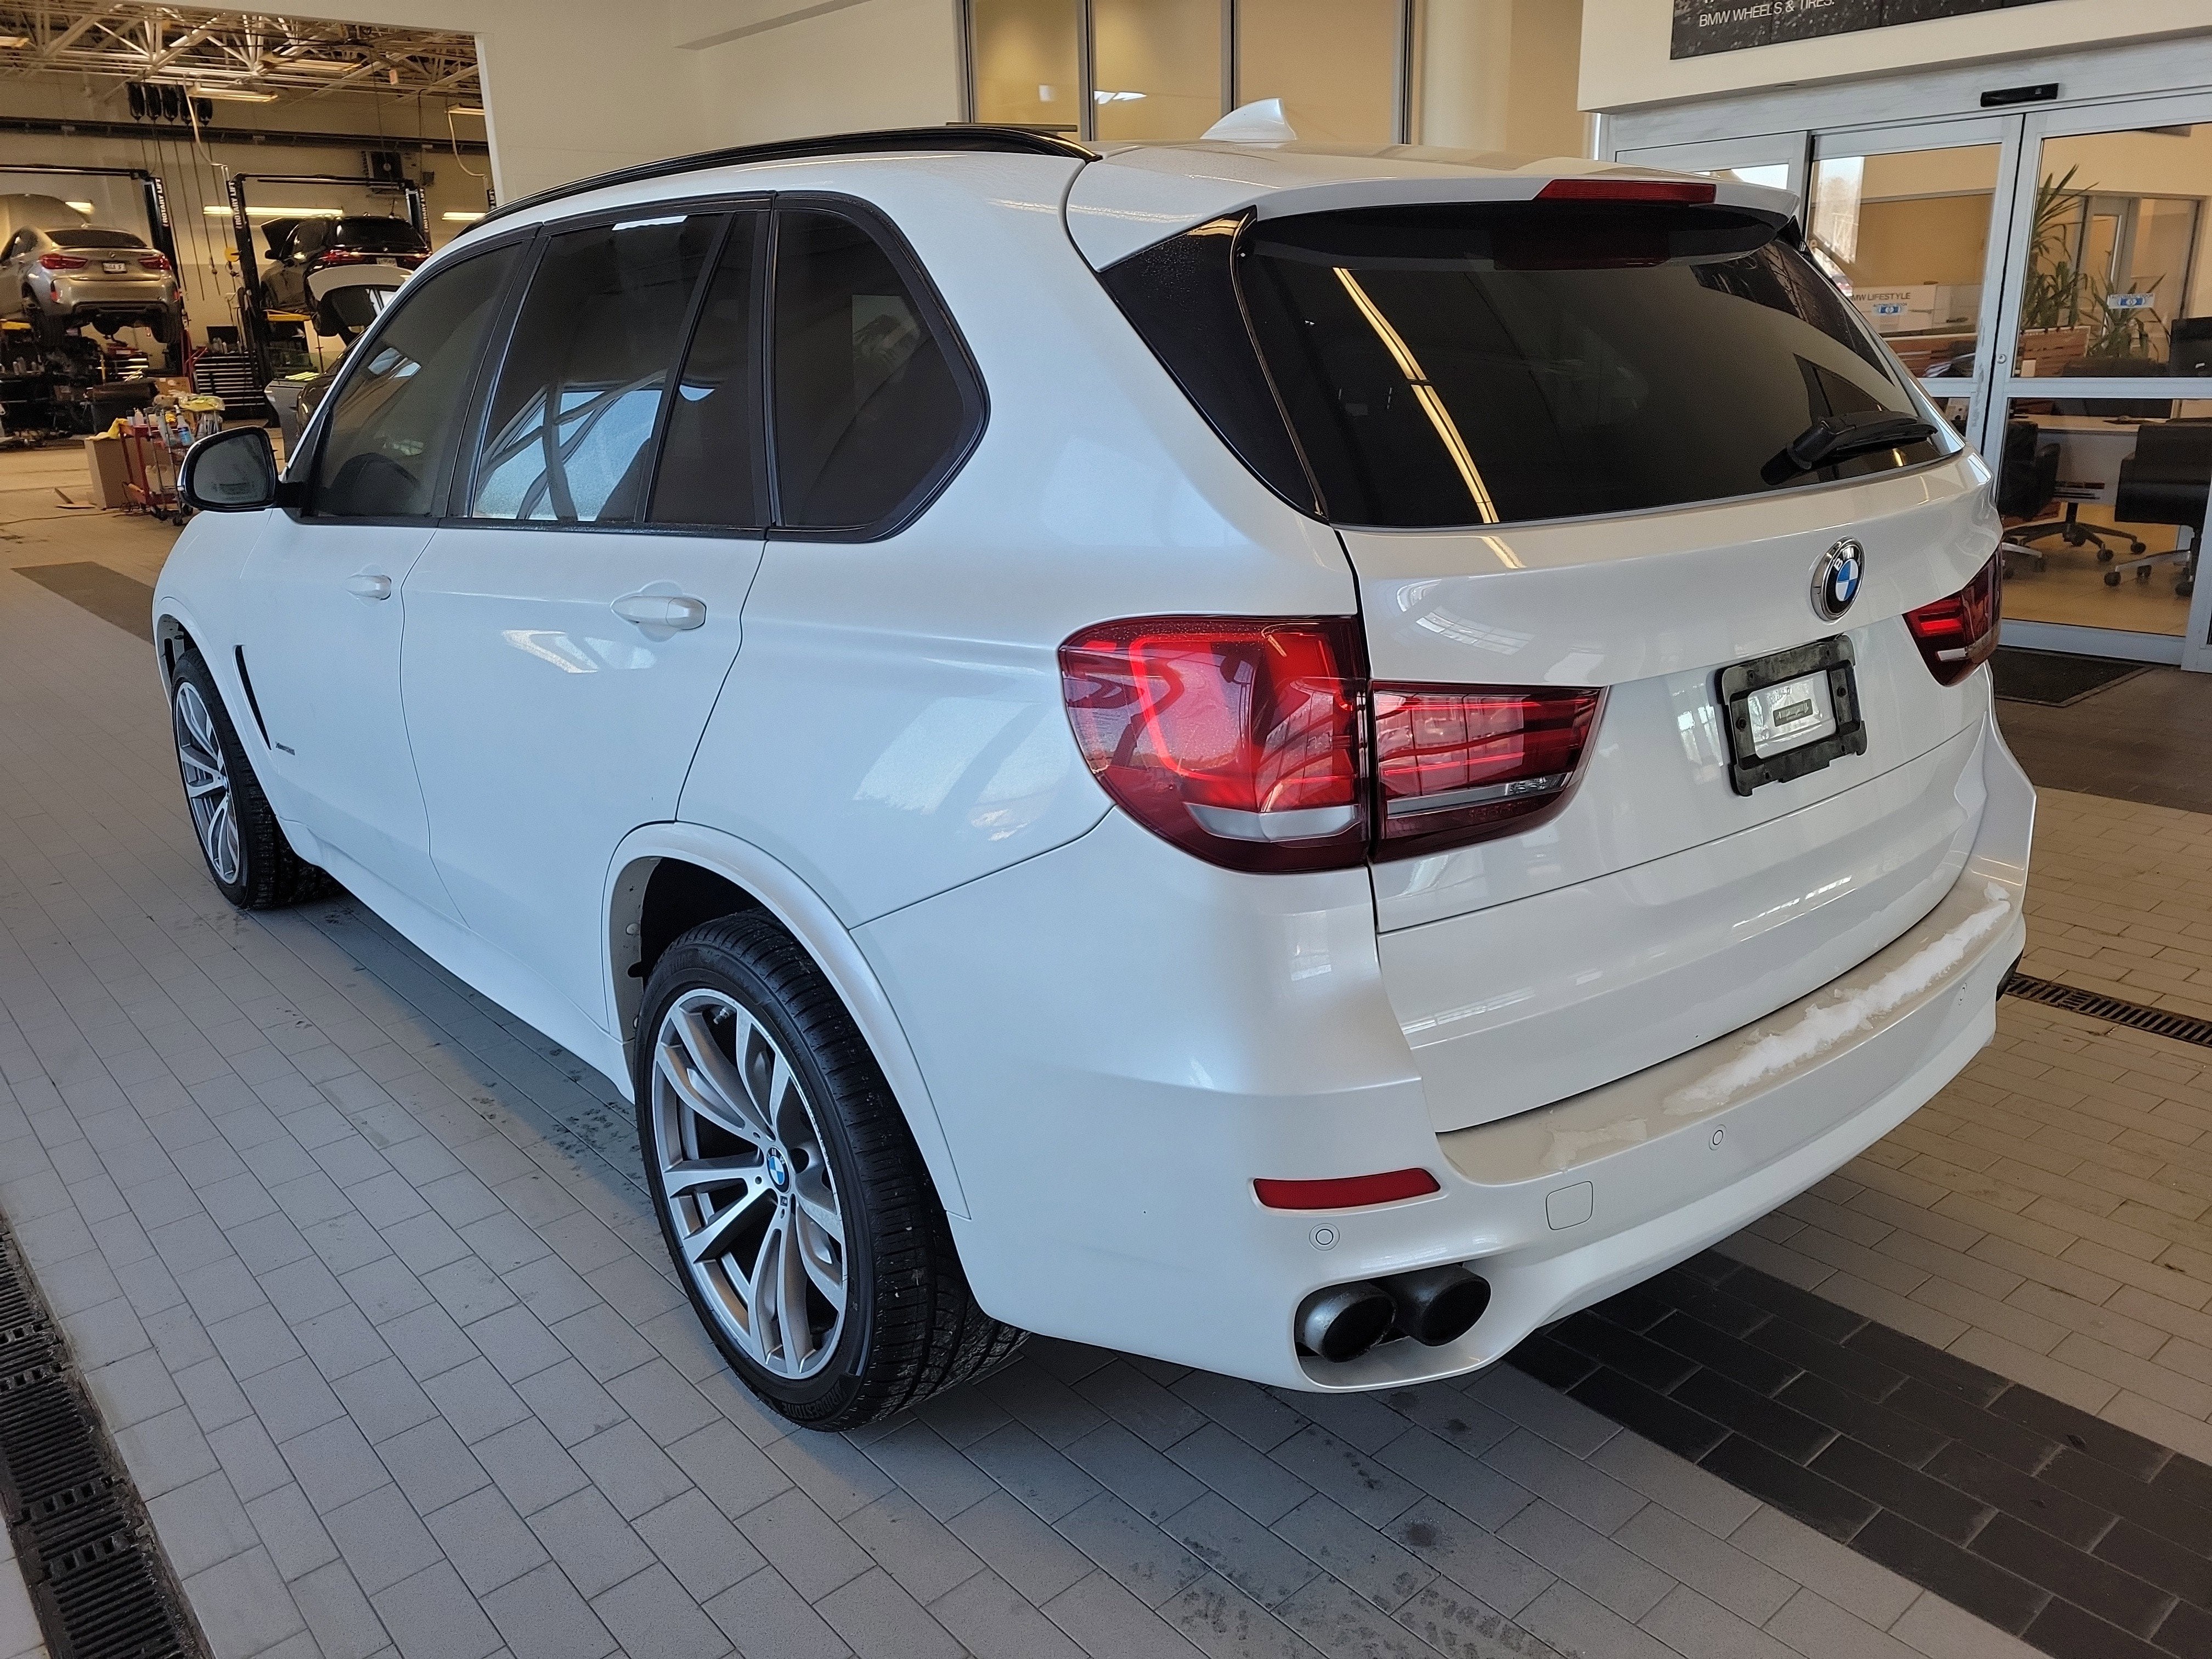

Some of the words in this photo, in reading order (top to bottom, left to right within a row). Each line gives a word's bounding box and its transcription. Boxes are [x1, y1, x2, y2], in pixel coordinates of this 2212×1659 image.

[1699, 10, 1730, 27] BMW
[1733, 2, 1783, 21] WHEELS
[1785, 0, 1795, 13] &
[155, 178, 163, 194] LIFT
[228, 182, 236, 196] LIFT
[159, 195, 169, 223] ROTARY
[231, 198, 242, 225] ROTARY
[1867, 292, 1911, 301] LIFESTYLE
[1833, 546, 1862, 571] BMW
